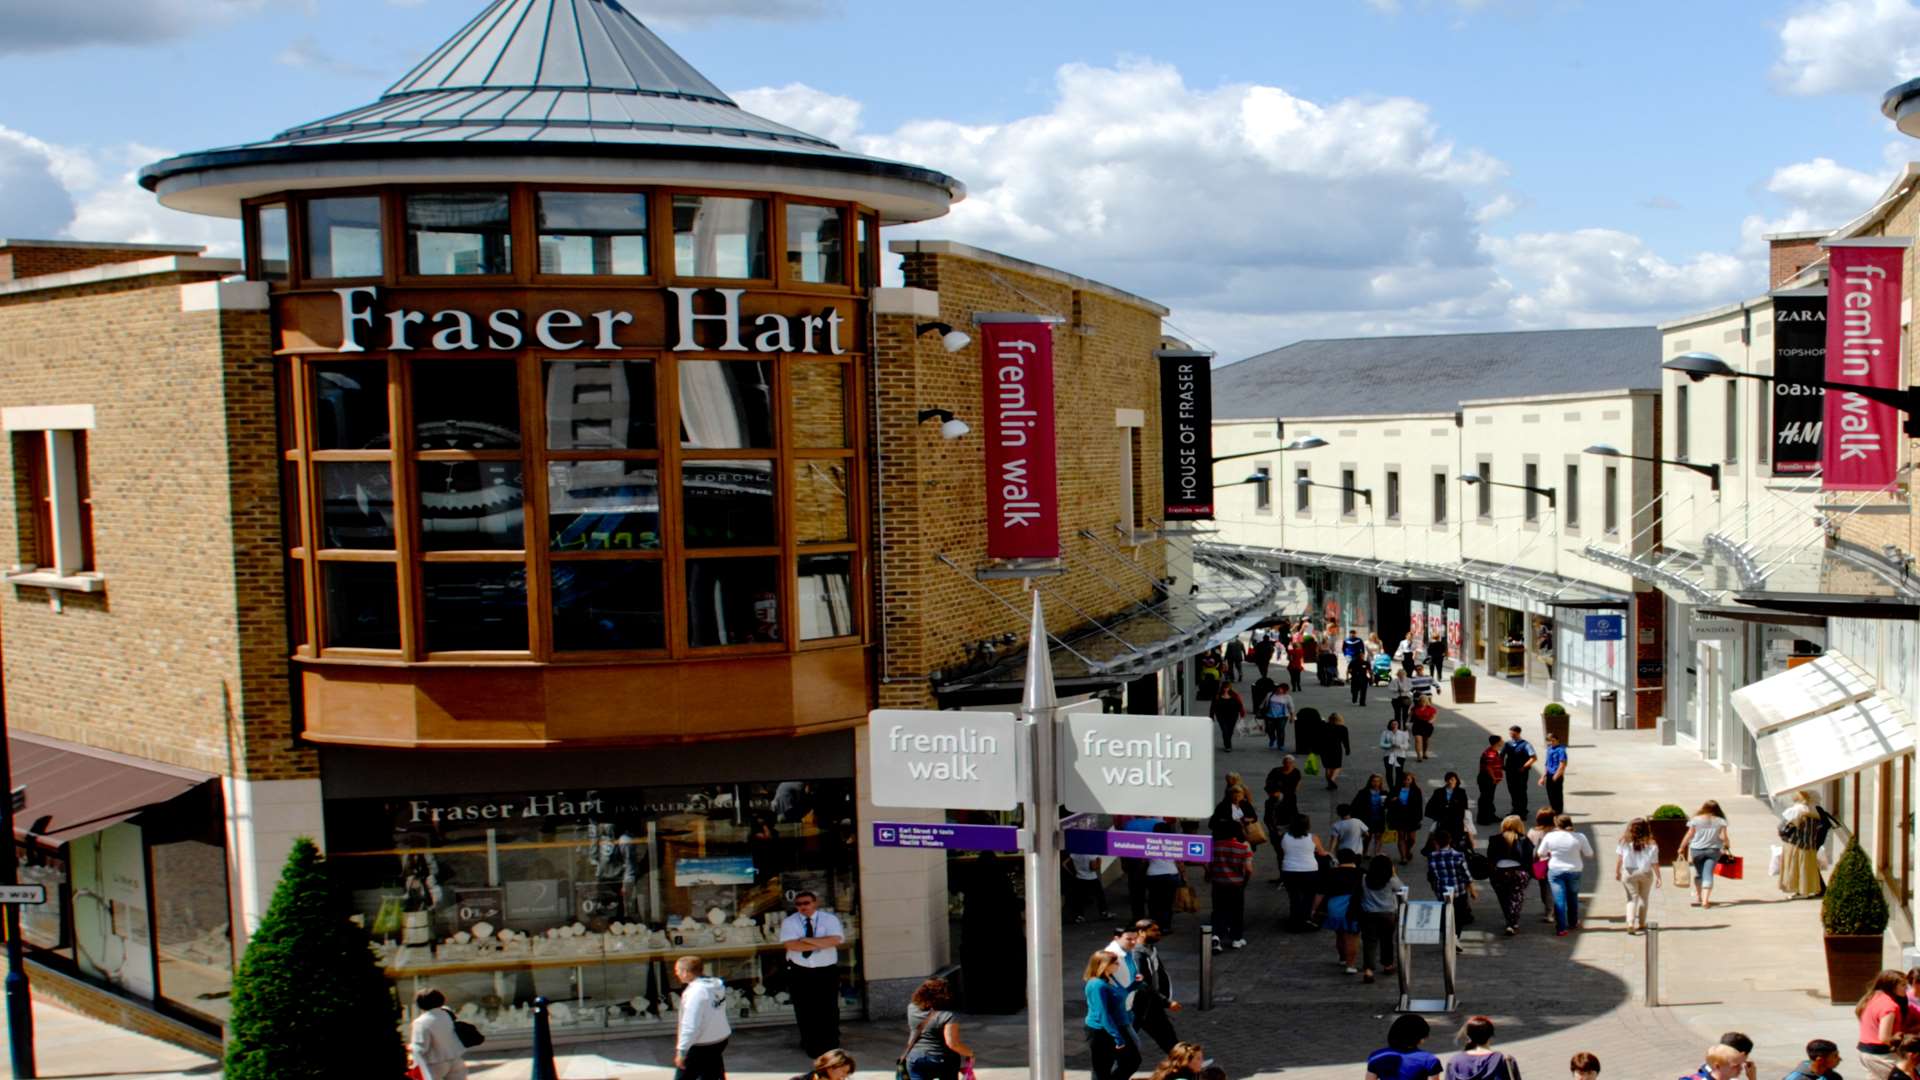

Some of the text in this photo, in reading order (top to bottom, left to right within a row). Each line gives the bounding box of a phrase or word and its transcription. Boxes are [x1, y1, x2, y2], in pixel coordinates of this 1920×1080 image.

[334, 286, 845, 355] Fraser Hart
[1777, 310, 1826, 321] ZARA
[1777, 348, 1827, 357] TOPSHOP
[1840, 264, 1886, 461] fremlin walk
[998, 340, 1041, 528] fremlin walk
[1178, 364, 1196, 499] HOUSE OF FRASER
[1778, 421, 1823, 445] H&M
[889, 725, 997, 755] fremlin
[1083, 730, 1192, 759] fremlin
[907, 754, 979, 782] walk
[1101, 760, 1174, 787] walk
[409, 800, 514, 823] Fraser
[528, 794, 605, 817] Hart
[9, 891, 36, 899] way
